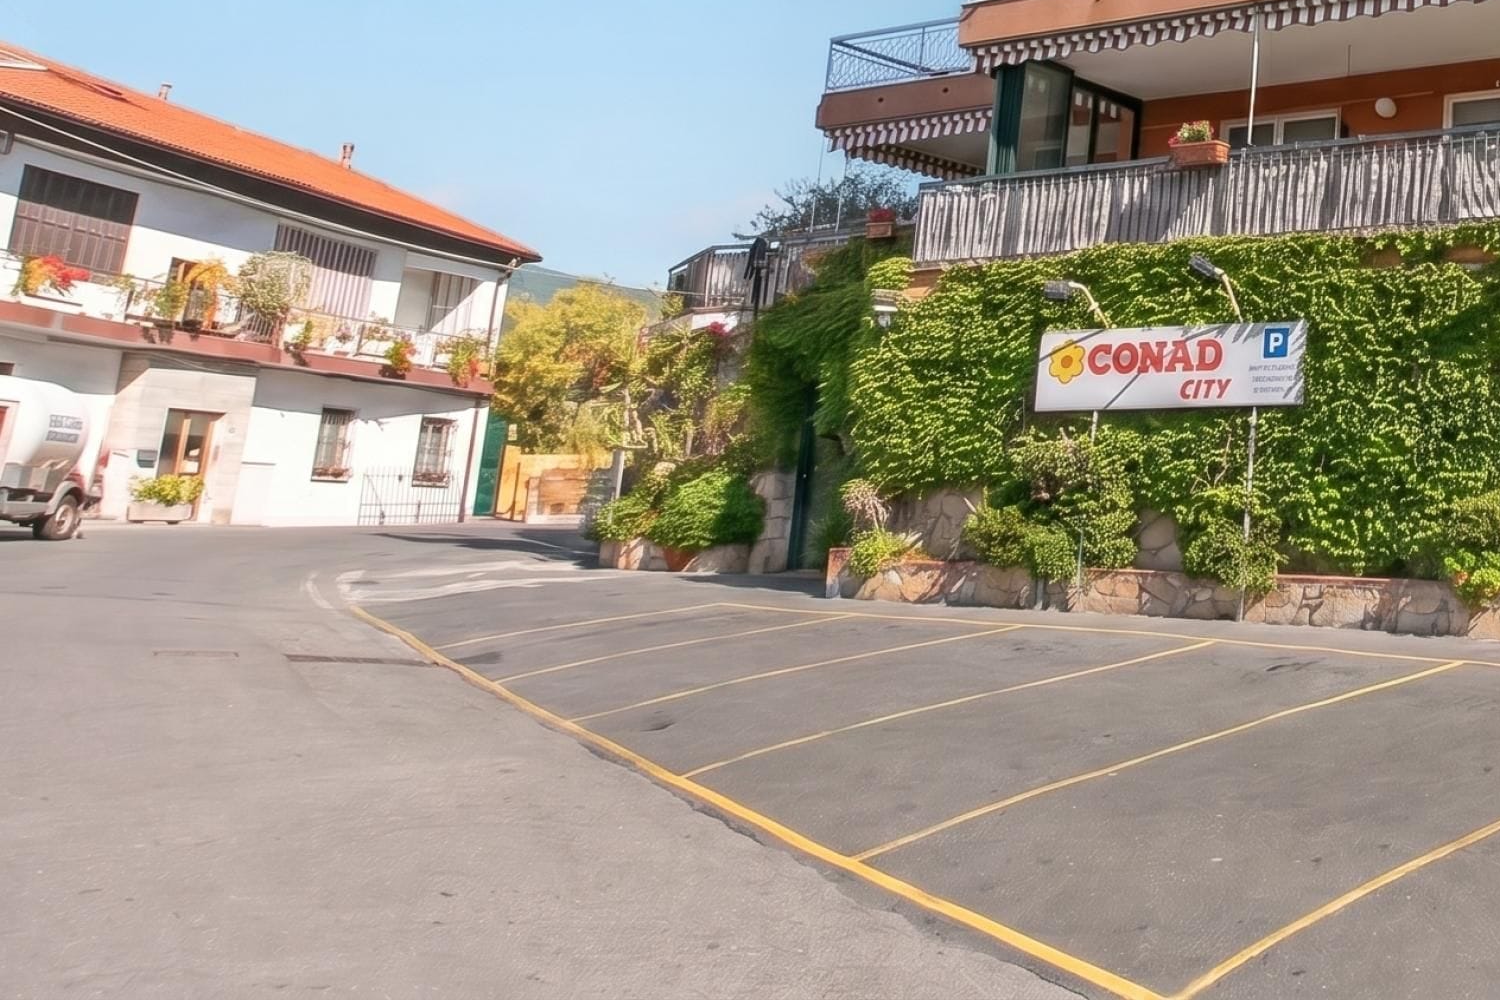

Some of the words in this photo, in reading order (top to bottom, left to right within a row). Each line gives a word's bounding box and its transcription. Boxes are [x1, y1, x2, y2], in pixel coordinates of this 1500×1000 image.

[1269, 332, 1284, 353] P
[1088, 339, 1224, 375] CONAD
[1180, 379, 1232, 400] CITY
